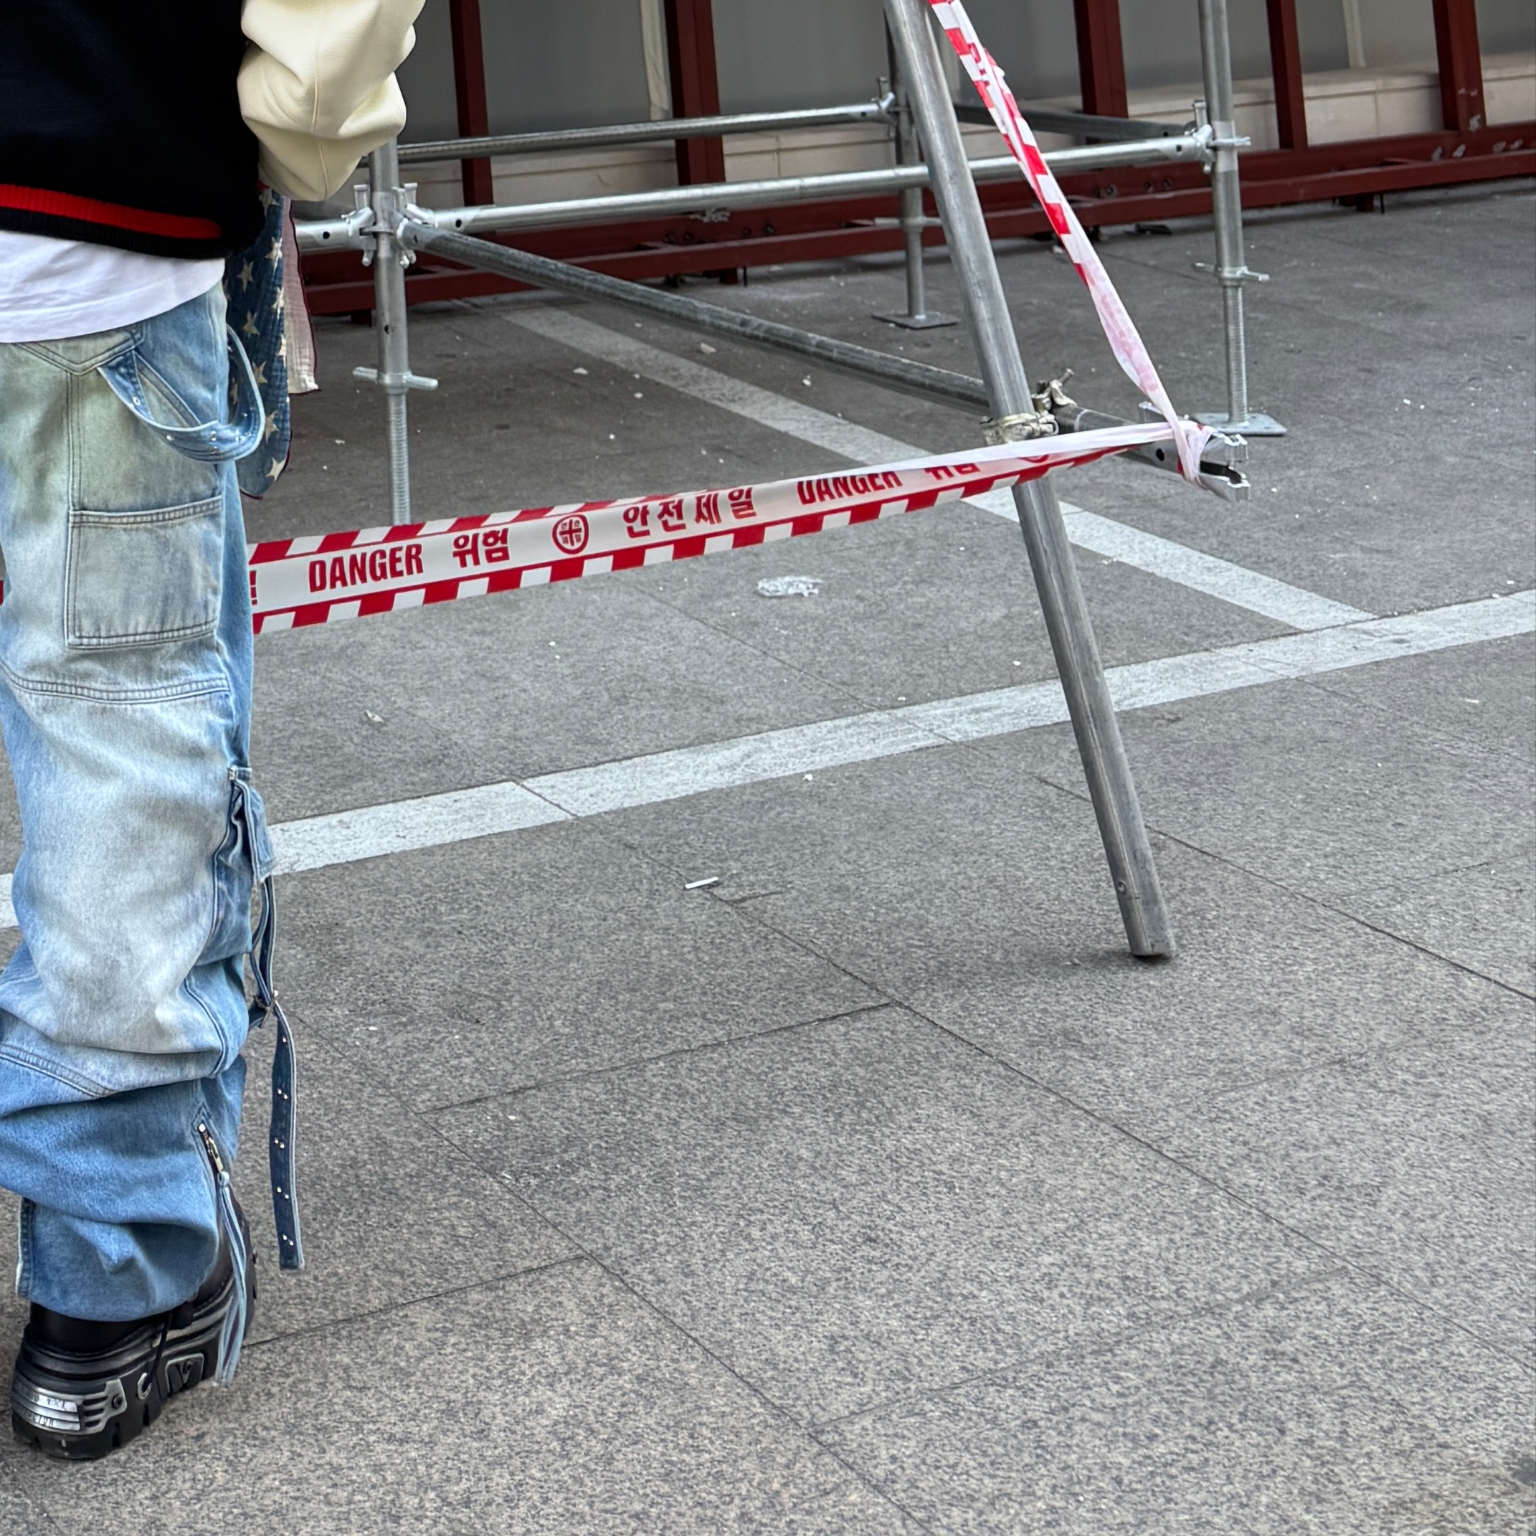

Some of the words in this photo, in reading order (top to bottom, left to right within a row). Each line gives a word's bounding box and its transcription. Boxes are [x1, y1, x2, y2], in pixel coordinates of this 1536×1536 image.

[308, 543, 424, 593] DANGER
[452, 526, 510, 569] 위험
[622, 486, 758, 539] 안전제일
